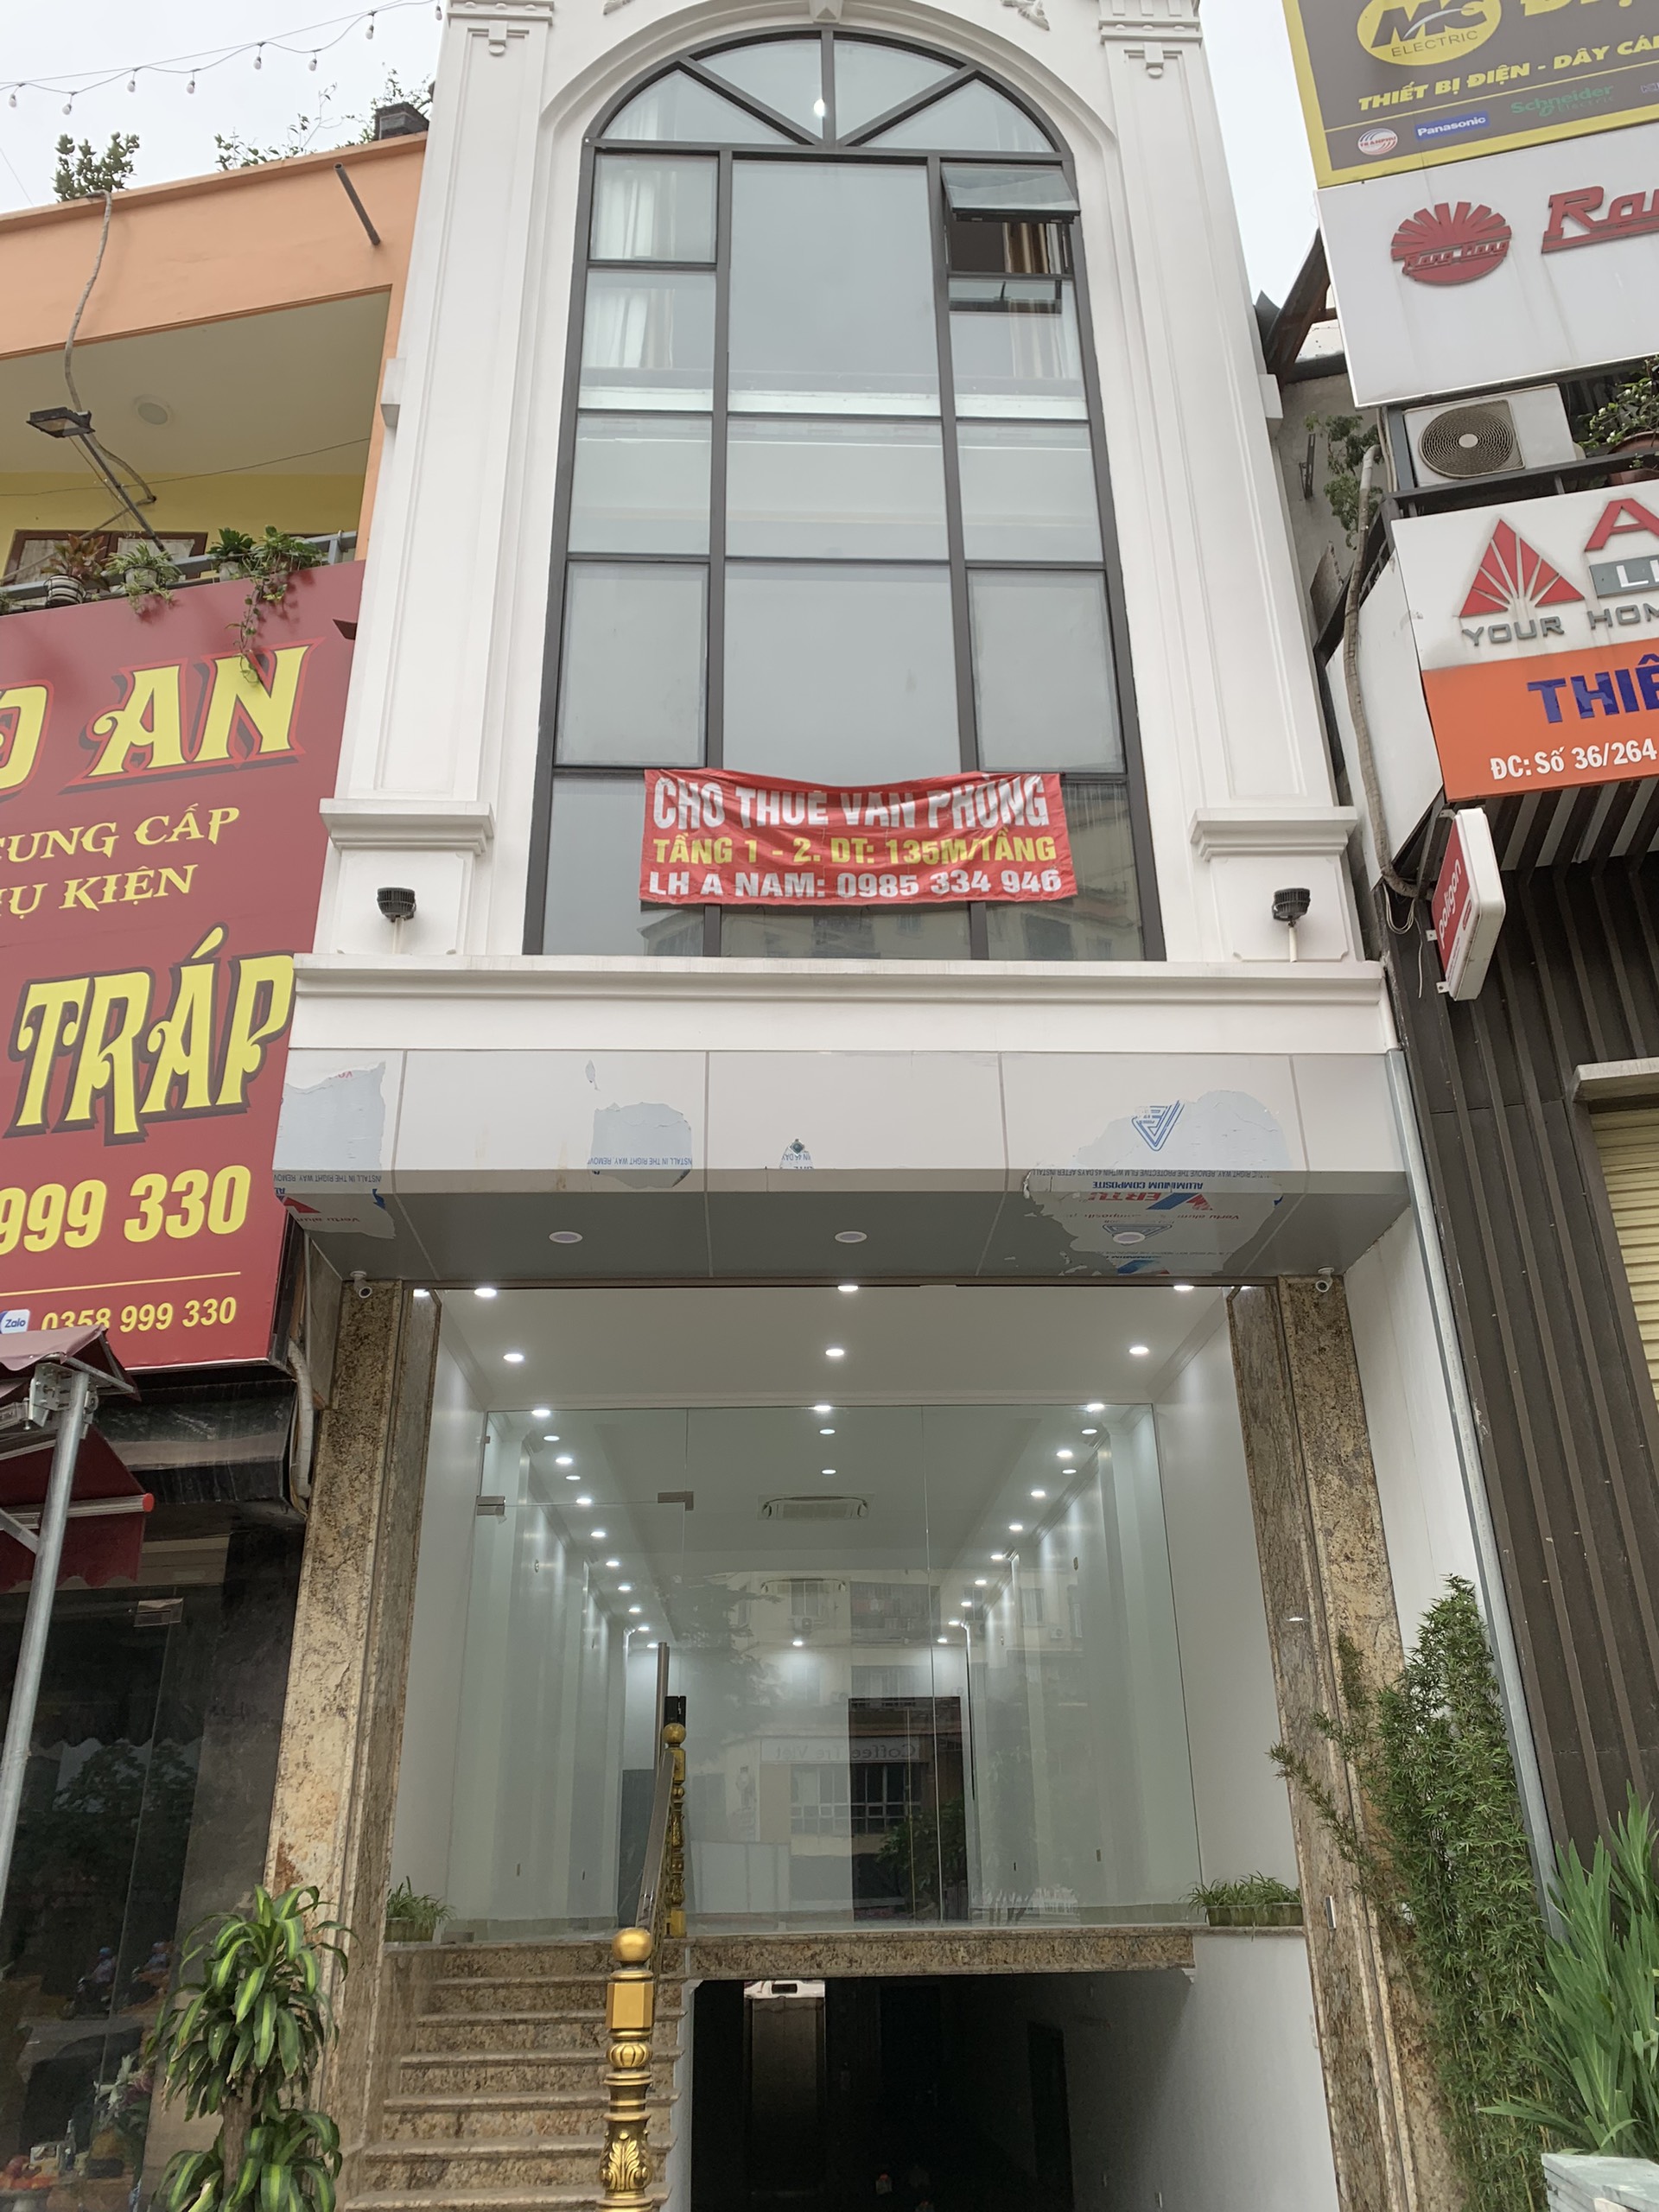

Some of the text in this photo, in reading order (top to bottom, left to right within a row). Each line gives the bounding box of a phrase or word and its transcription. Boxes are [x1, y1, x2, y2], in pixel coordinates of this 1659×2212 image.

[1391, 30, 1478, 57] ELECTRIC
[1358, 81, 1429, 111] THIẾT
[1434, 78, 1461, 95] BỊ
[1466, 62, 1529, 86] ĐIỆN
[1554, 46, 1610, 70] DÂY
[1617, 35, 1659, 55] CÁ
[1510, 85, 1611, 114] Schneider
[1417, 116, 1487, 137] Panasonic
[1542, 186, 1659, 240] Ra
[1462, 616, 1565, 647] YOUR
[88, 645, 310, 778] AN
[1490, 737, 1658, 779] ĐC: Số 36/264
[653, 776, 726, 830] CHO
[0, 804, 239, 862] UNG CẤP
[653, 832, 733, 864] TẦNG
[745, 840, 757, 862] 1
[793, 837, 821, 863] 2.
[831, 838, 875, 864] DT:
[0, 864, 199, 919] Ụ KIỆN
[650, 868, 1062, 899] LH A NAM: 0985 334 946
[1439, 858, 1462, 950] poligon
[16, 926, 296, 1135] TRÁP
[315, 1174, 334, 1183] RIGHT
[1092, 1181, 1204, 1190] ALUMINIUM COMPOSITE
[0, 1165, 251, 1256] 999 330
[4, 1318, 27, 1329] Zalo
[119, 1302, 174, 1333] 999
[181, 1296, 237, 1328] 330
